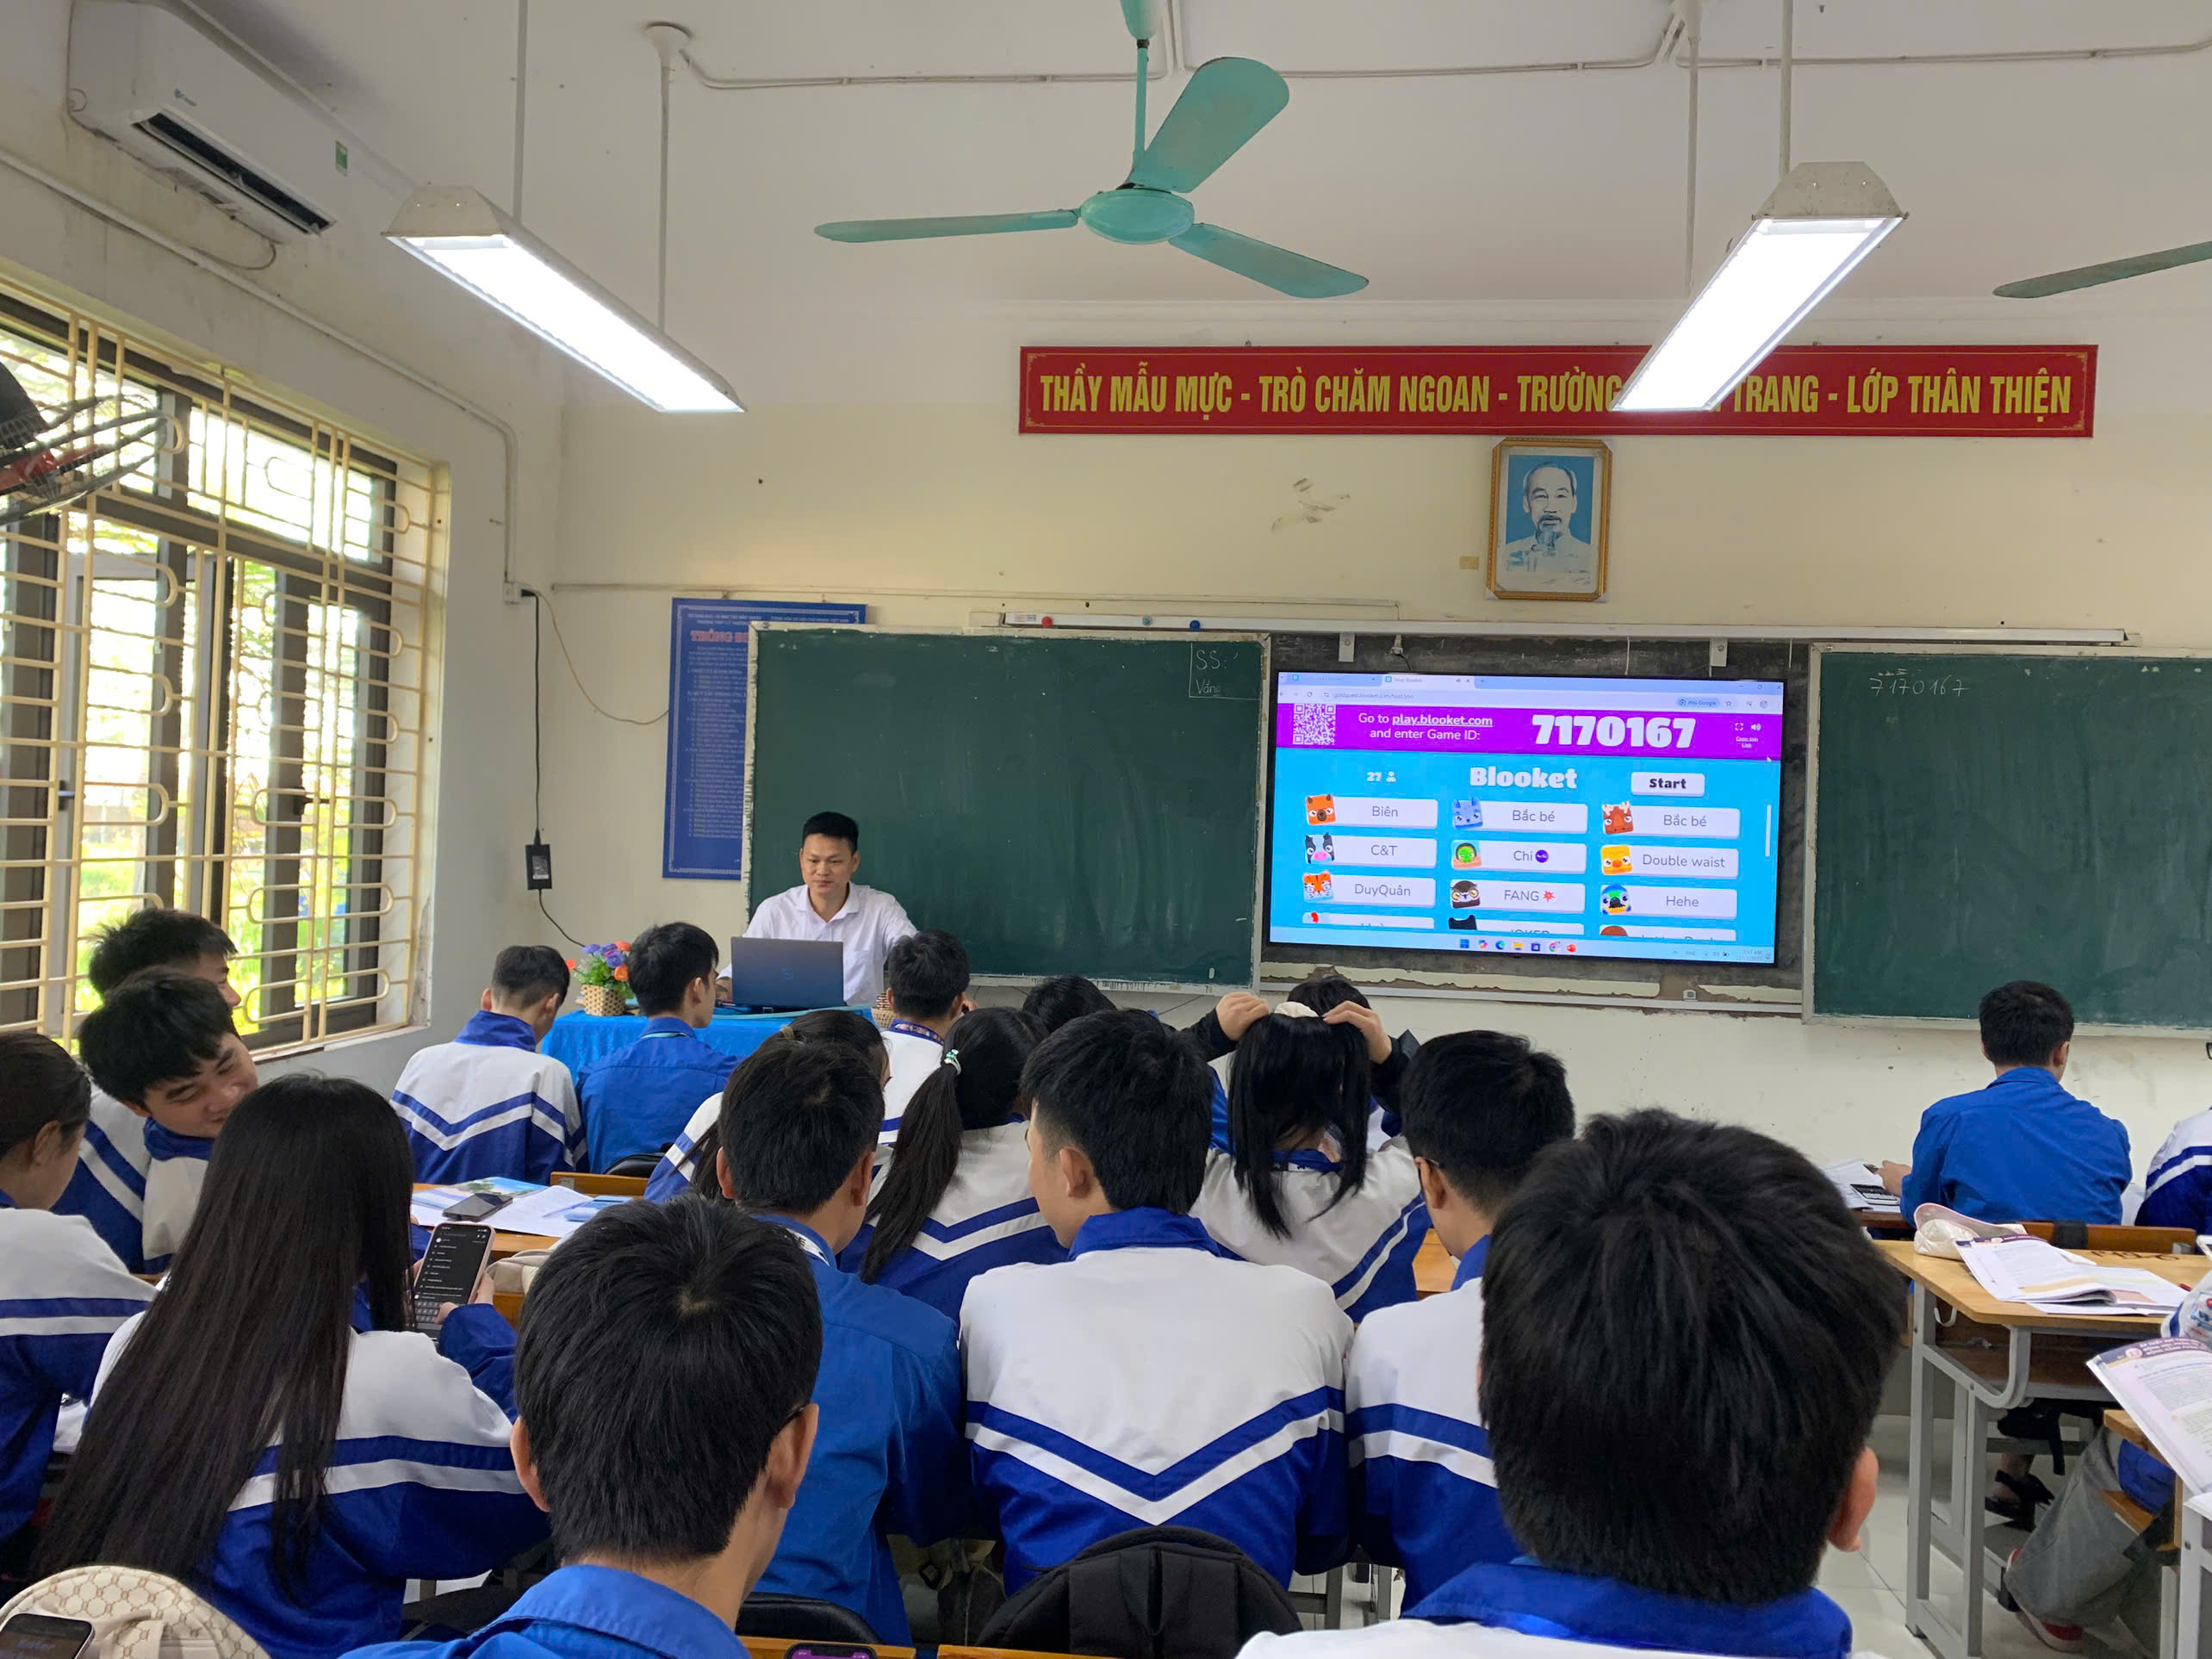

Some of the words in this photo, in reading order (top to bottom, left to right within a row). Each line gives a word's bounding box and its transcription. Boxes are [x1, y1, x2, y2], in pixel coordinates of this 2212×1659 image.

[1040, 362, 1103, 412] THẦY
[1109, 361, 1167, 412] MẪU
[1175, 371, 1233, 420] MỰC
[1258, 366, 1307, 413] TRÒ
[1314, 367, 1391, 413] CHĂM
[1398, 375, 1490, 413] NGOAN
[1847, 367, 1899, 413] LỚP
[1908, 367, 1981, 413] THÂN
[1990, 367, 2072, 422] THIỆN
[1869, 675, 1970, 697] 7170167
[1358, 712, 1375, 724] Go
[1377, 714, 1389, 724] to
[1392, 714, 1493, 727] play.blooket.com
[1370, 729, 1392, 739] and
[1394, 731, 1423, 740] enter
[1426, 730, 1462, 741] Game
[1463, 730, 1481, 741] ID:
[1532, 714, 1697, 749] 7170167
[1366, 771, 1382, 783] 27
[1469, 766, 1578, 789] Blooket
[1649, 778, 1687, 790] Start
[1371, 805, 1399, 817] Biên
[1512, 809, 1537, 822] Bắc
[1539, 811, 1556, 823] bé
[1662, 813, 1688, 827] Bắc
[1691, 816, 1707, 828] bé
[1370, 844, 1398, 856] C&T
[1513, 850, 1533, 861] Chi
[1642, 854, 1689, 867] Double
[1691, 859, 1725, 868] waist
[1354, 884, 1411, 898] DuyQuân
[1504, 890, 1540, 902] FANG
[1666, 896, 1699, 908] Hehe
